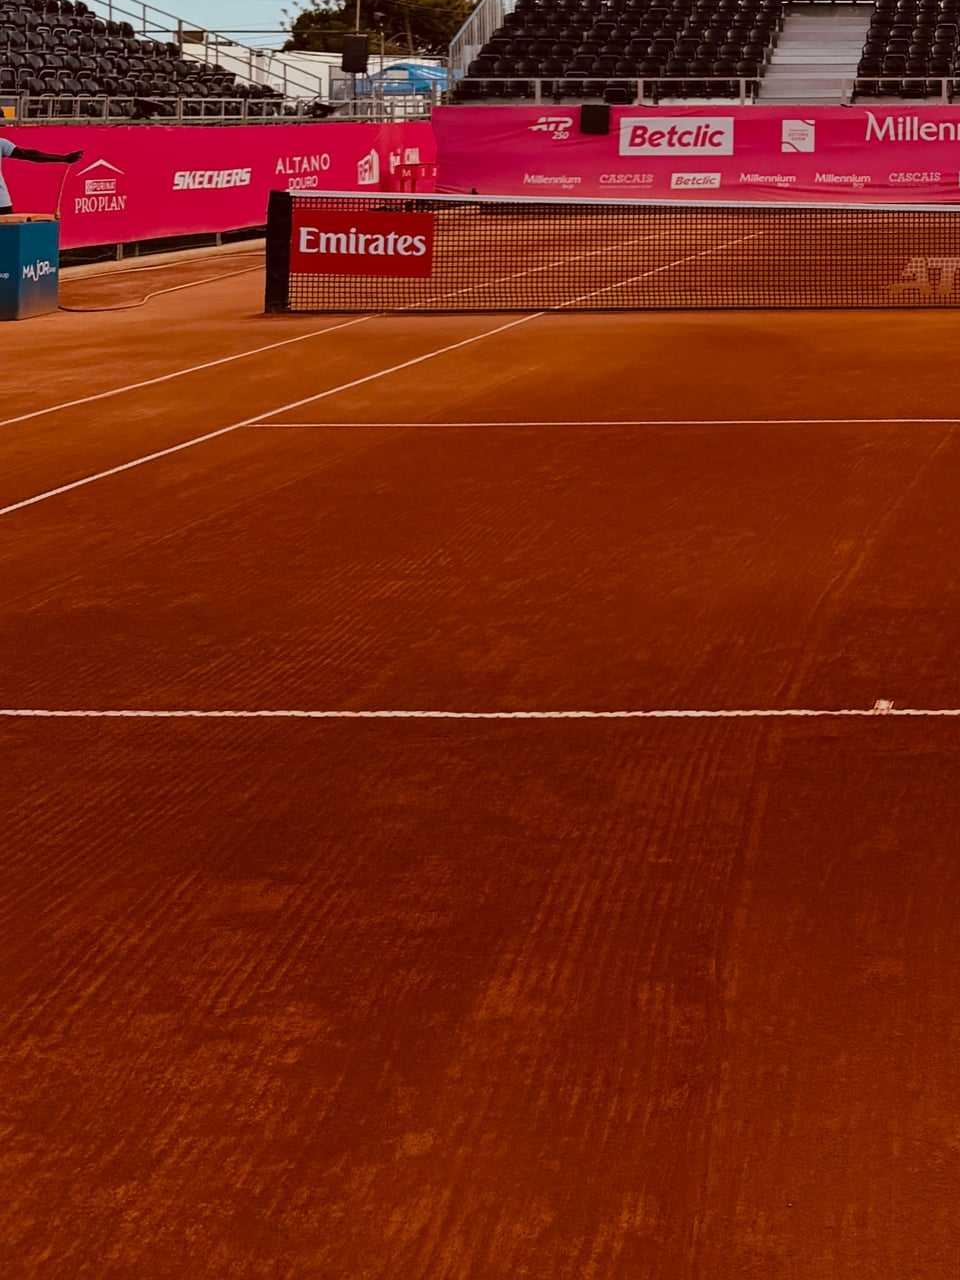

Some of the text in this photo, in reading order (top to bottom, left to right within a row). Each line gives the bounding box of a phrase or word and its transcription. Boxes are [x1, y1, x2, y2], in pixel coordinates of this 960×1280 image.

[528, 117, 573, 131] ATP
[552, 131, 570, 139] 250
[628, 124, 725, 147] Betclic
[275, 153, 331, 174] ALTANO
[172, 168, 251, 190] SKECHERS
[523, 173, 581, 184] Millennium
[600, 174, 653, 184] CASCAIS
[675, 176, 717, 185] Betclic
[739, 173, 796, 183] Millennium
[815, 173, 871, 183] Millennium
[889, 172, 941, 182] CASCAIS
[288, 176, 319, 190] DOURO
[299, 227, 426, 256] Emirates
